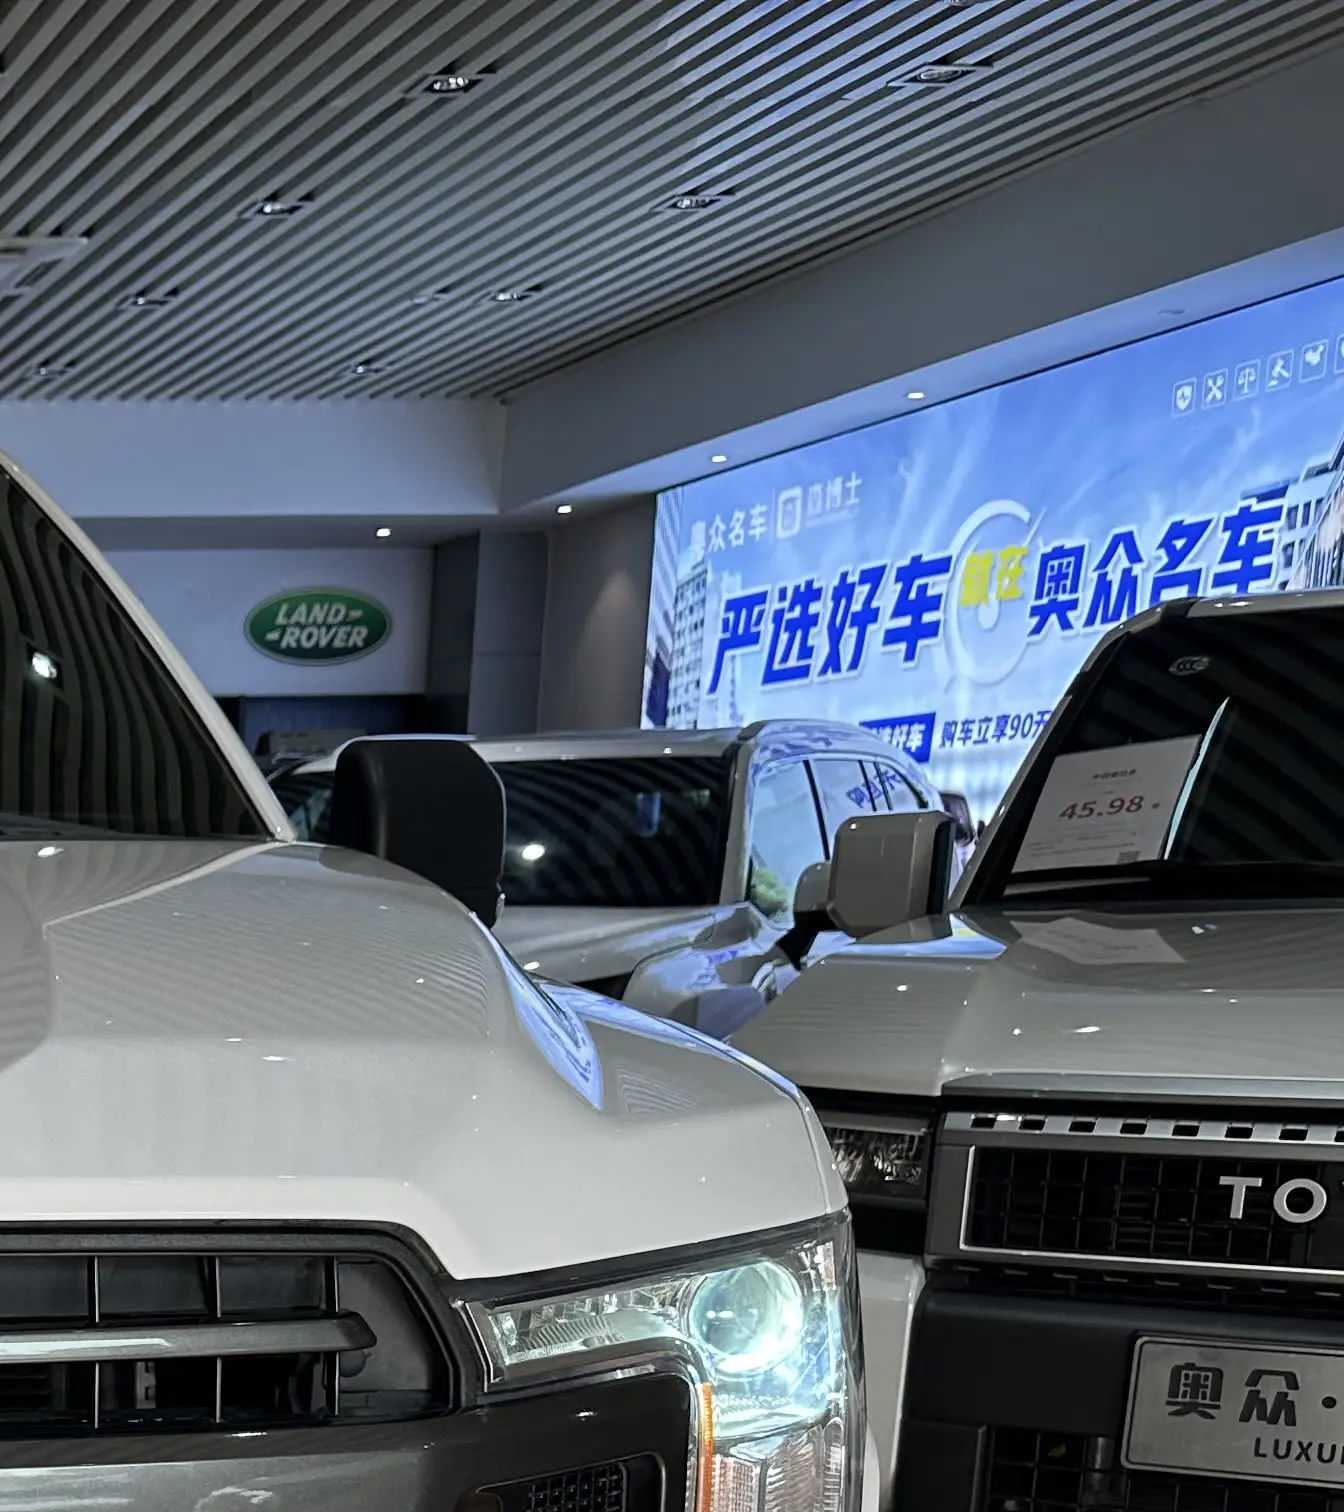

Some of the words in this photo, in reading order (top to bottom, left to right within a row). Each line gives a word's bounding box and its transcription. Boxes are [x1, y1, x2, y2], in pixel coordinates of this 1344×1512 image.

[707, 553, 953, 695] 严选好车
[1027, 503, 1285, 638] 奥众名车
[275, 602, 347, 625] LAND
[279, 626, 369, 649] ROVER
[1059, 796, 1144, 820] 45.98
[1218, 1175, 1344, 1224] TO
[1253, 1437, 1344, 1467] LUXU
